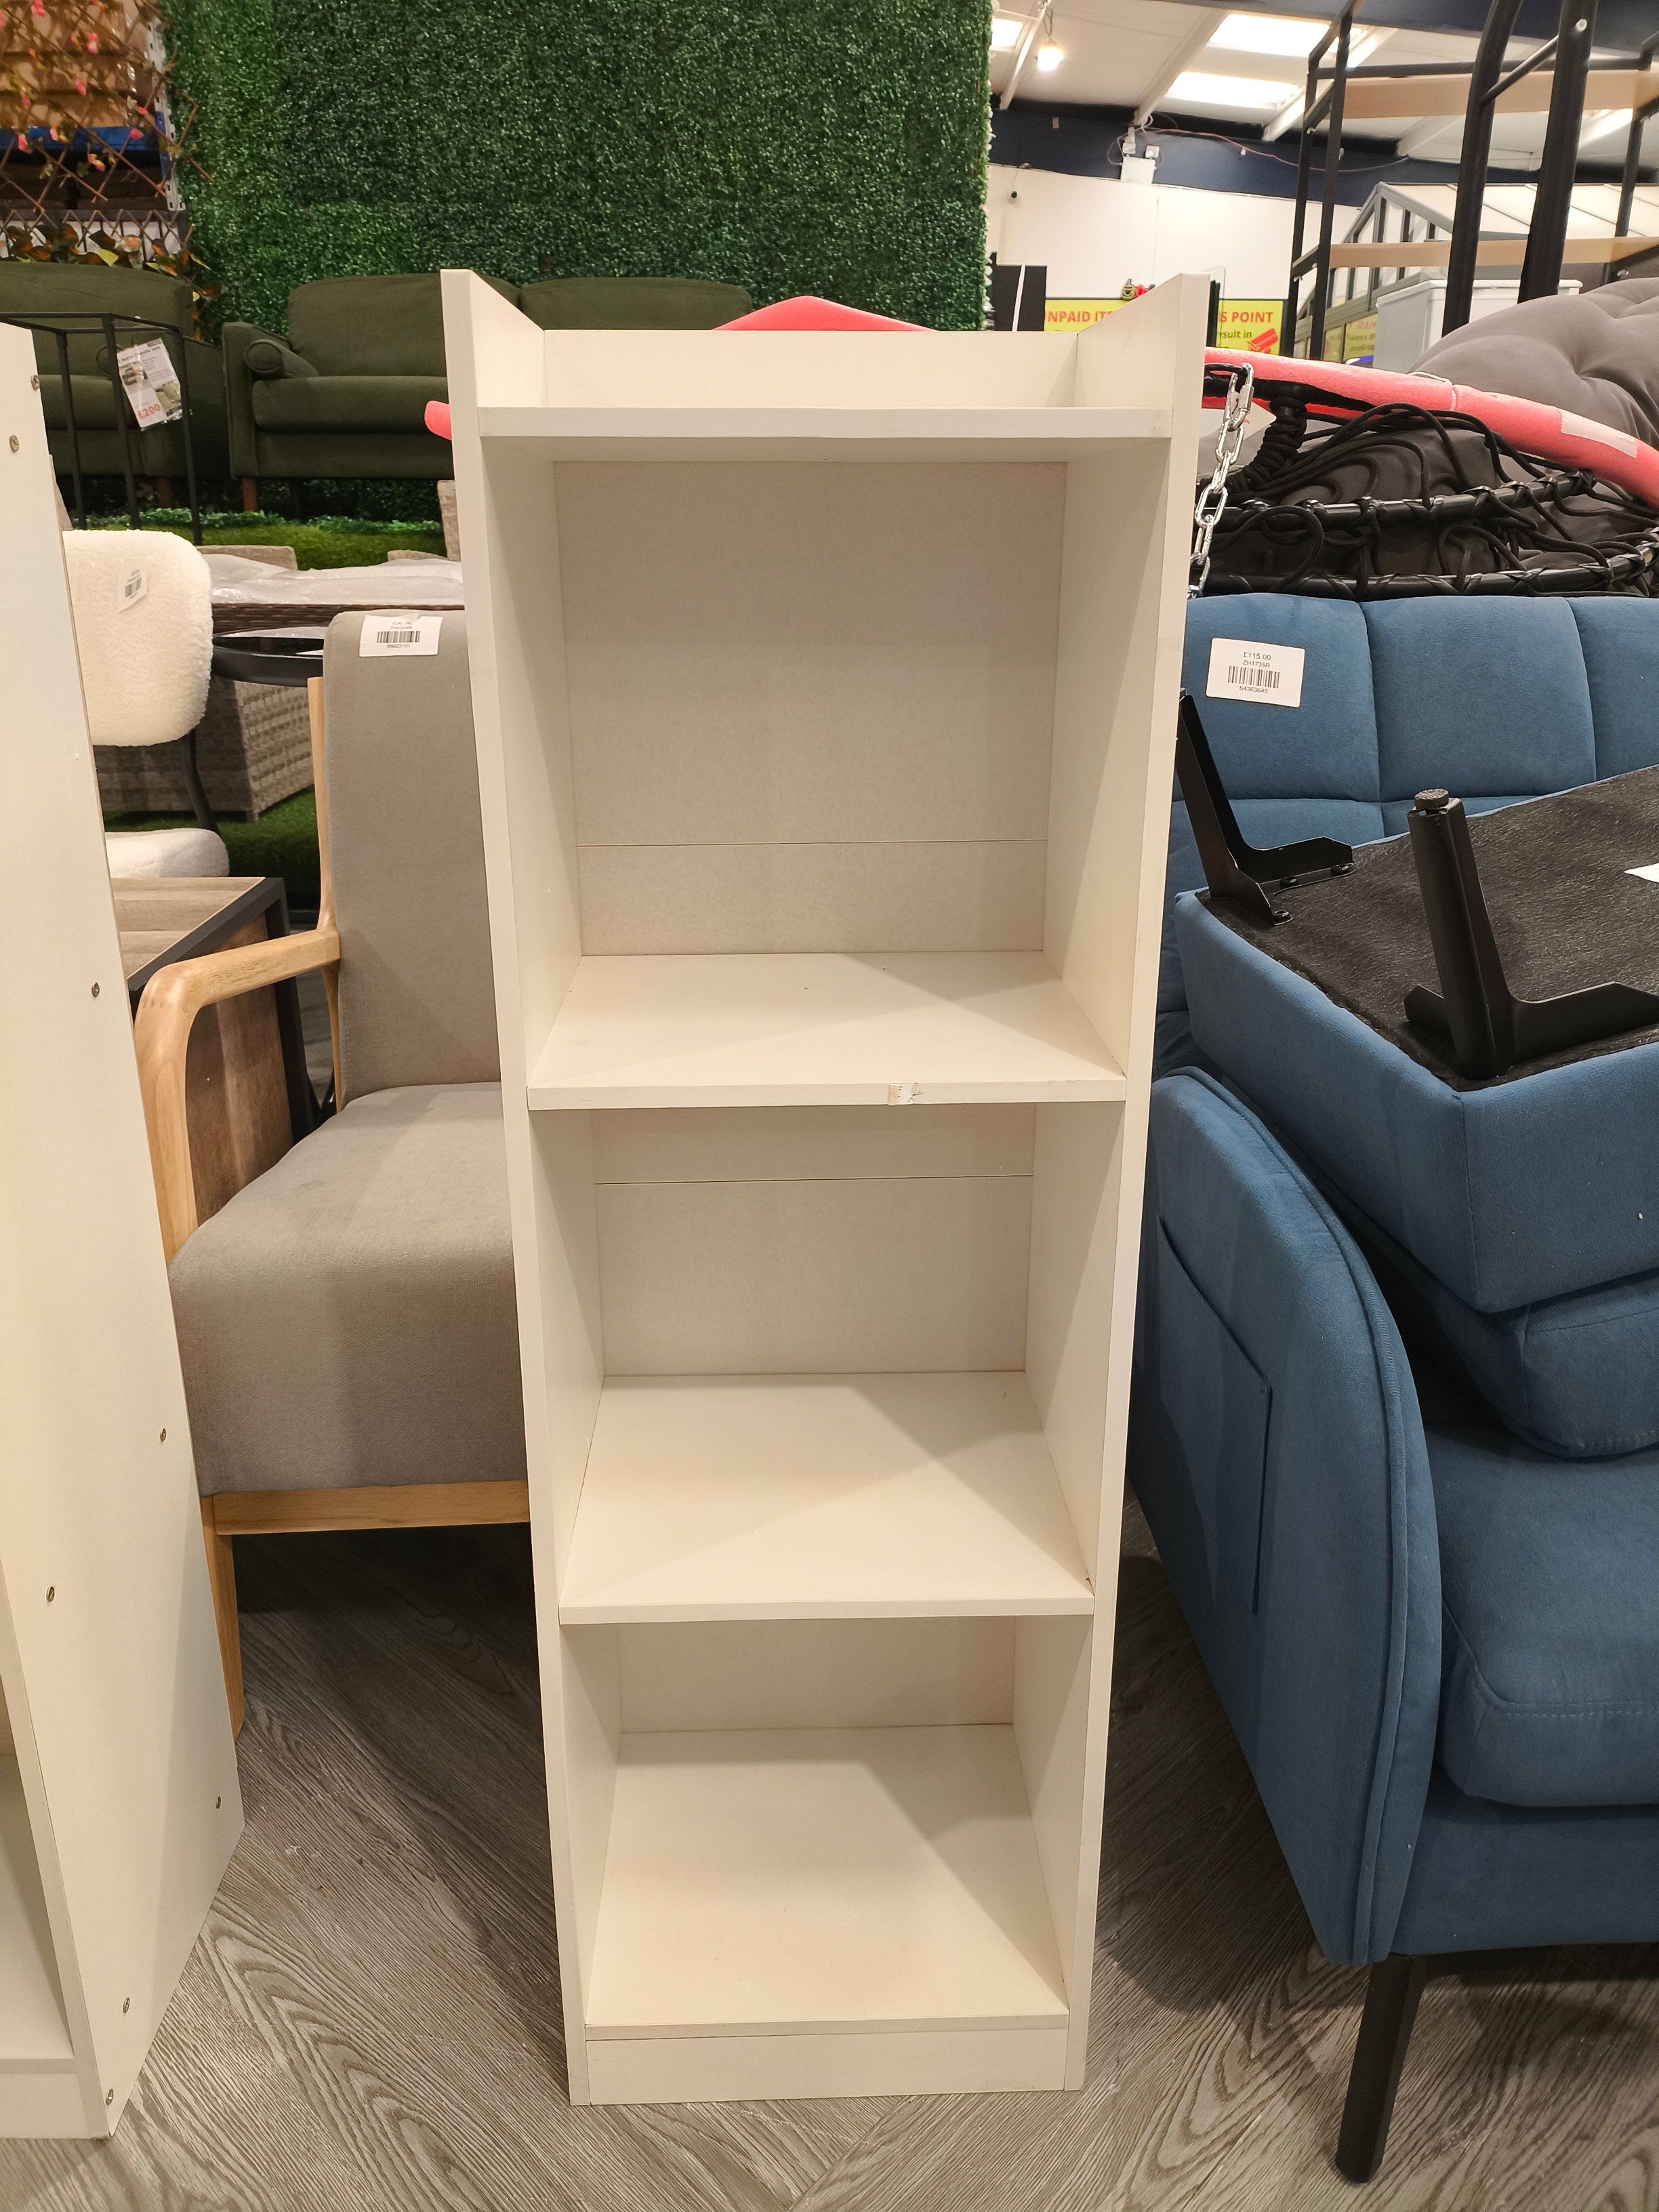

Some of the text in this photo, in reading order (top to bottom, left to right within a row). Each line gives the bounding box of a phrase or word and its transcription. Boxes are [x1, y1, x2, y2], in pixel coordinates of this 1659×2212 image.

[1045, 310, 1090, 323] NPAID
[1231, 311, 1273, 323] POINT
[1244, 329, 1252, 338] in
[138, 403, 161, 419] £200
[1243, 651, 1271, 661] £115.00
